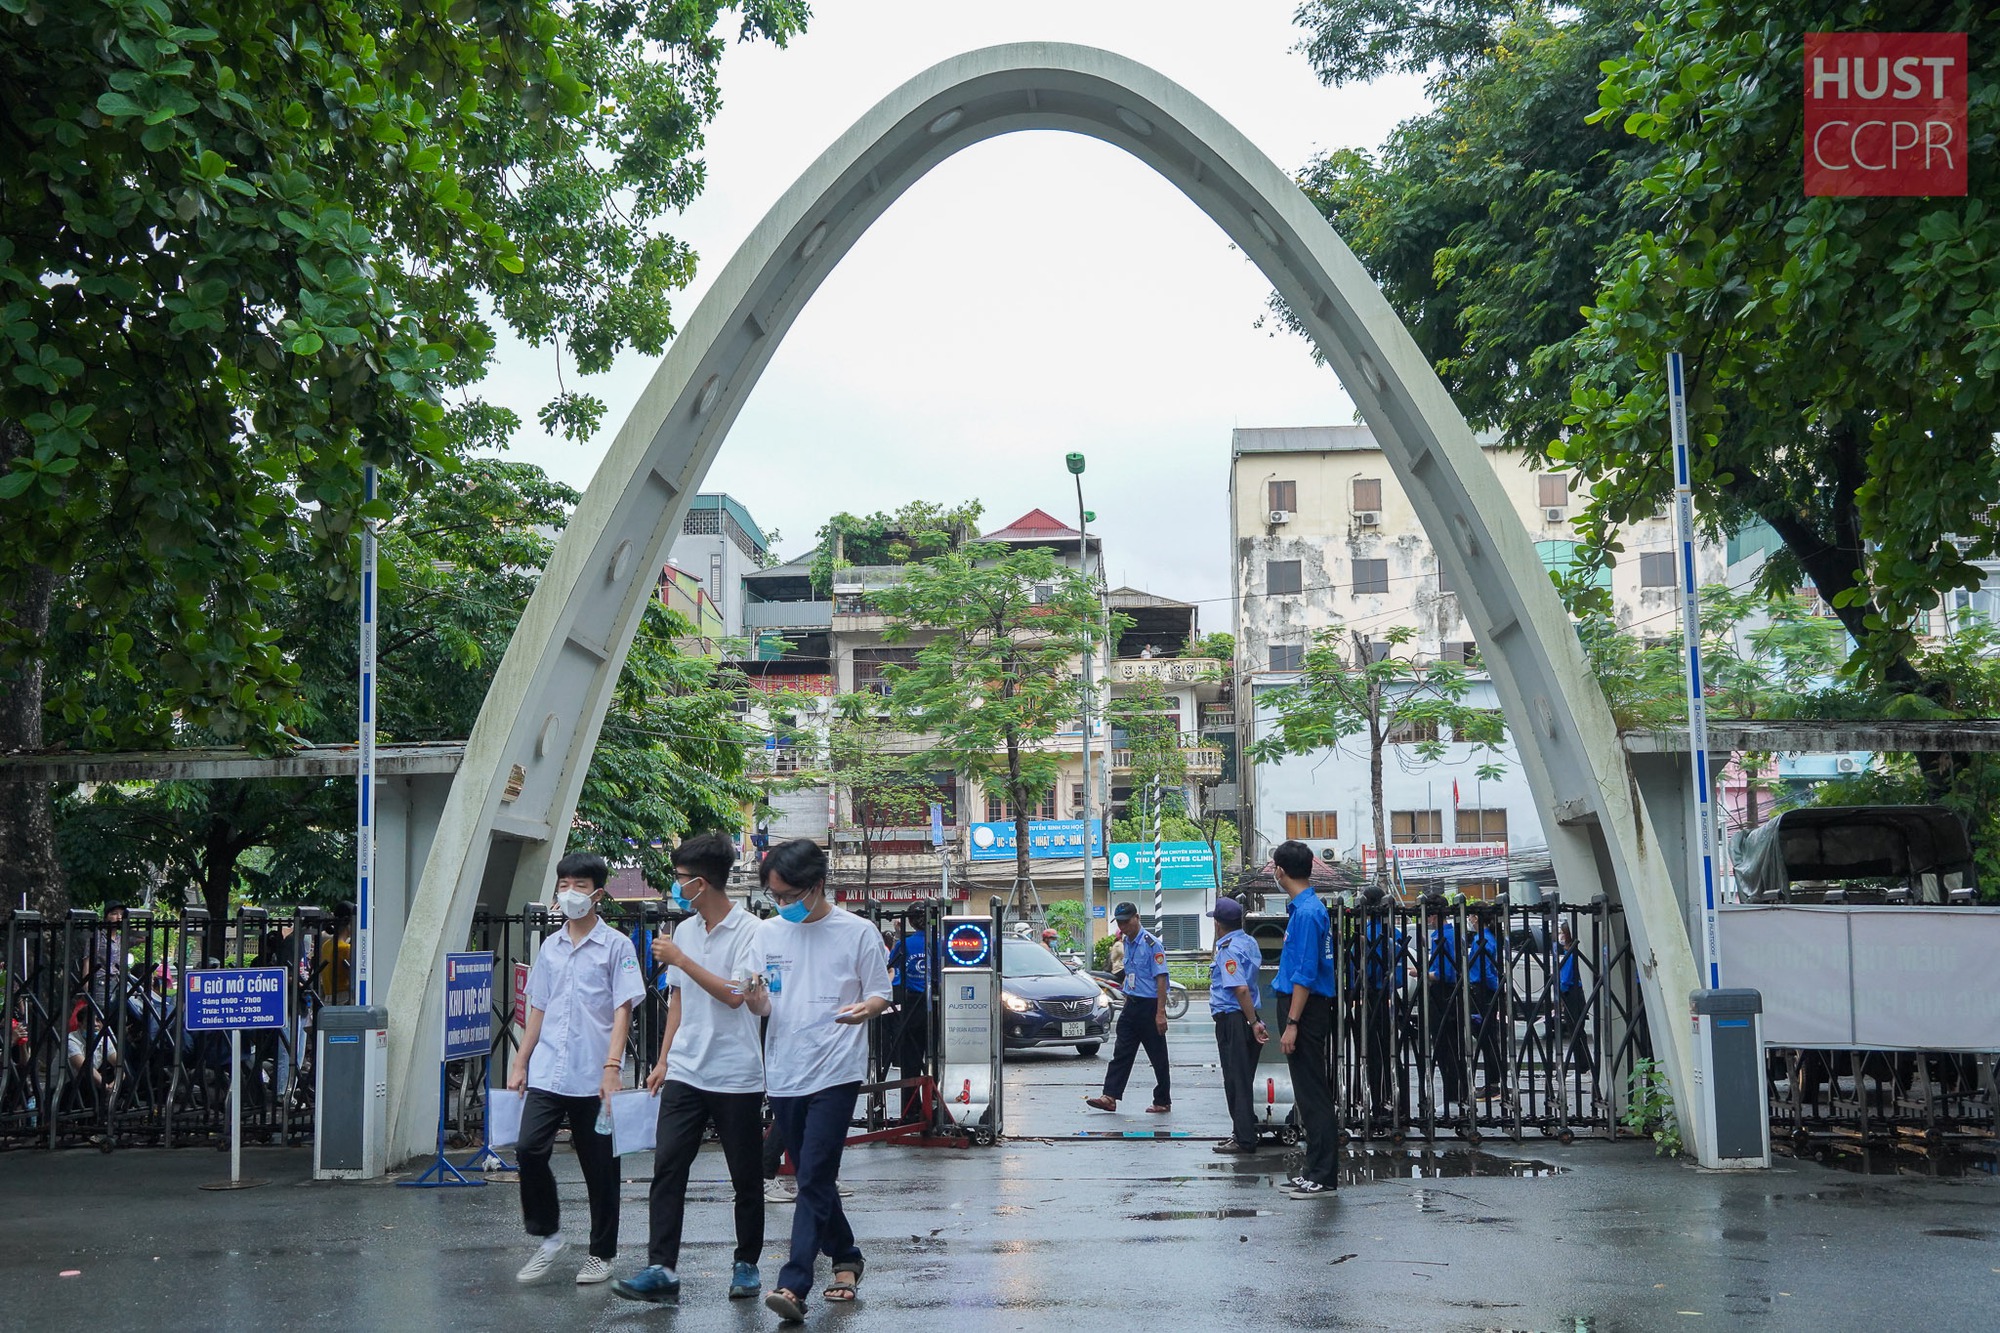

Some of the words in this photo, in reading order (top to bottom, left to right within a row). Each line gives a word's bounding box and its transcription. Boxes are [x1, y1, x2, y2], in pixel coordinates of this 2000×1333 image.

[204, 977, 223, 994] GIỜ
[226, 975, 245, 993] MỞ
[247, 973, 278, 993] CỔNG
[449, 990, 463, 1017] KHU
[464, 986, 477, 1021] VỰC
[478, 978, 491, 1014] CẤM
